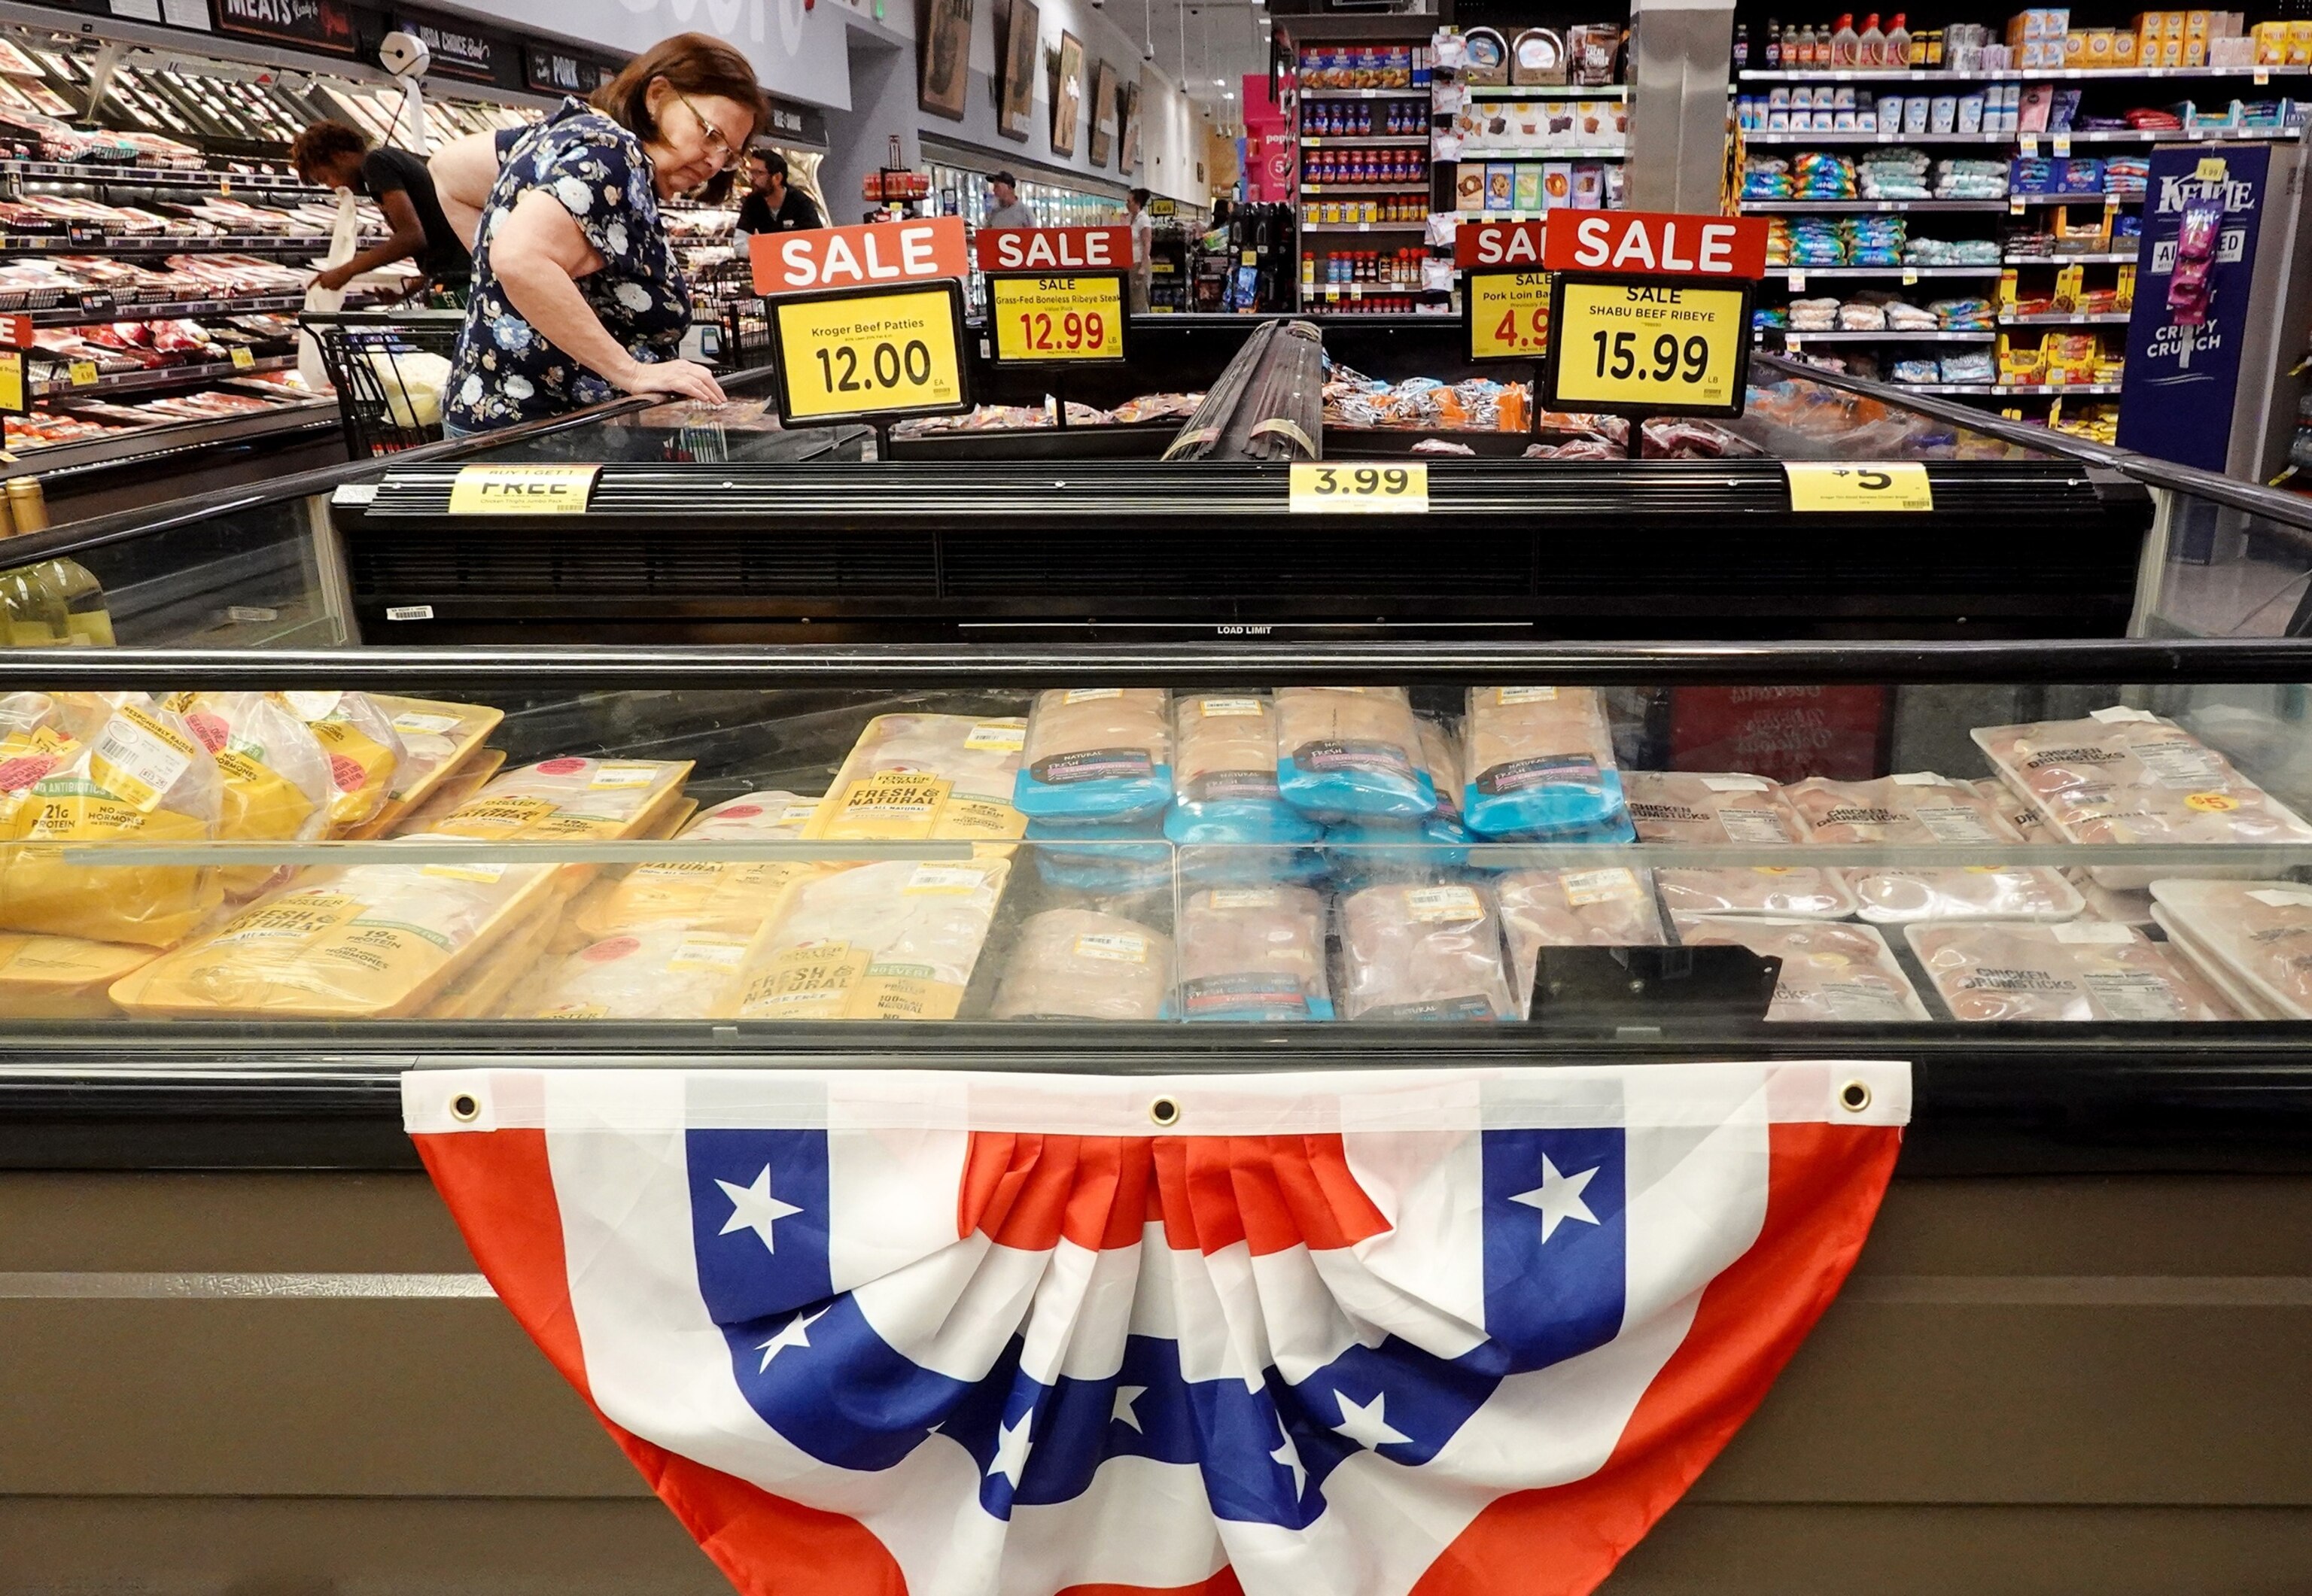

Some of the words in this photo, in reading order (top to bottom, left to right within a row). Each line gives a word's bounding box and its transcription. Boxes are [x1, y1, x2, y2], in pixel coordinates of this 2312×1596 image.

[998, 231, 1112, 267] SALE
[1477, 226, 1545, 264] SA
[1574, 218, 1736, 273] SALE
[781, 226, 938, 287] SALE
[1039, 278, 1076, 290] SALE
[1516, 273, 1553, 285] SALE
[996, 295, 1034, 305] Grass-Fed
[1036, 295, 1069, 304] Boneless
[1072, 294, 1098, 305] Ribeye
[1483, 292, 1507, 301] Pork
[1510, 291, 1532, 299] Loin
[1535, 290, 1551, 299] Ba
[1626, 287, 1682, 304] SALE
[1590, 306, 1632, 318] SHABU
[1635, 307, 1667, 320] BEEF
[1671, 310, 1716, 323] RIBEYE
[811, 327, 851, 338] Kroger
[855, 322, 881, 333] Beef
[884, 319, 925, 331] Patties
[1021, 312, 1104, 350] 12.99
[1593, 330, 1709, 384] 15.99
[816, 339, 931, 394] 12.00
[1708, 376, 1719, 385] LB
[482, 482, 568, 494] FREE
[1314, 468, 1409, 495] 3.99
[1217, 626, 1243, 635] LOAD
[1246, 626, 1272, 635] LIMIT
[123, 706, 171, 738] RESPONSIBLY
[169, 734, 194, 755] RAISED
[2037, 747, 2103, 758] CHICKEN
[2026, 752, 2126, 769] DRUMSTICKS
[48, 782, 107, 795] ANTIBIOTICS
[853, 788, 917, 798] FRESH
[847, 796, 936, 807] NATURAL
[1630, 802, 1693, 814] CHICKEN
[88, 812, 147, 826] HORMONES
[1826, 808, 1891, 817] CHICKEN
[31, 819, 76, 828] PROTEIN
[1816, 813, 1911, 827] DRUMSTICKS
[346, 935, 402, 950] PROTEIN
[325, 948, 389, 969] HORMONES
[1976, 968, 2051, 980] CHICKEN
